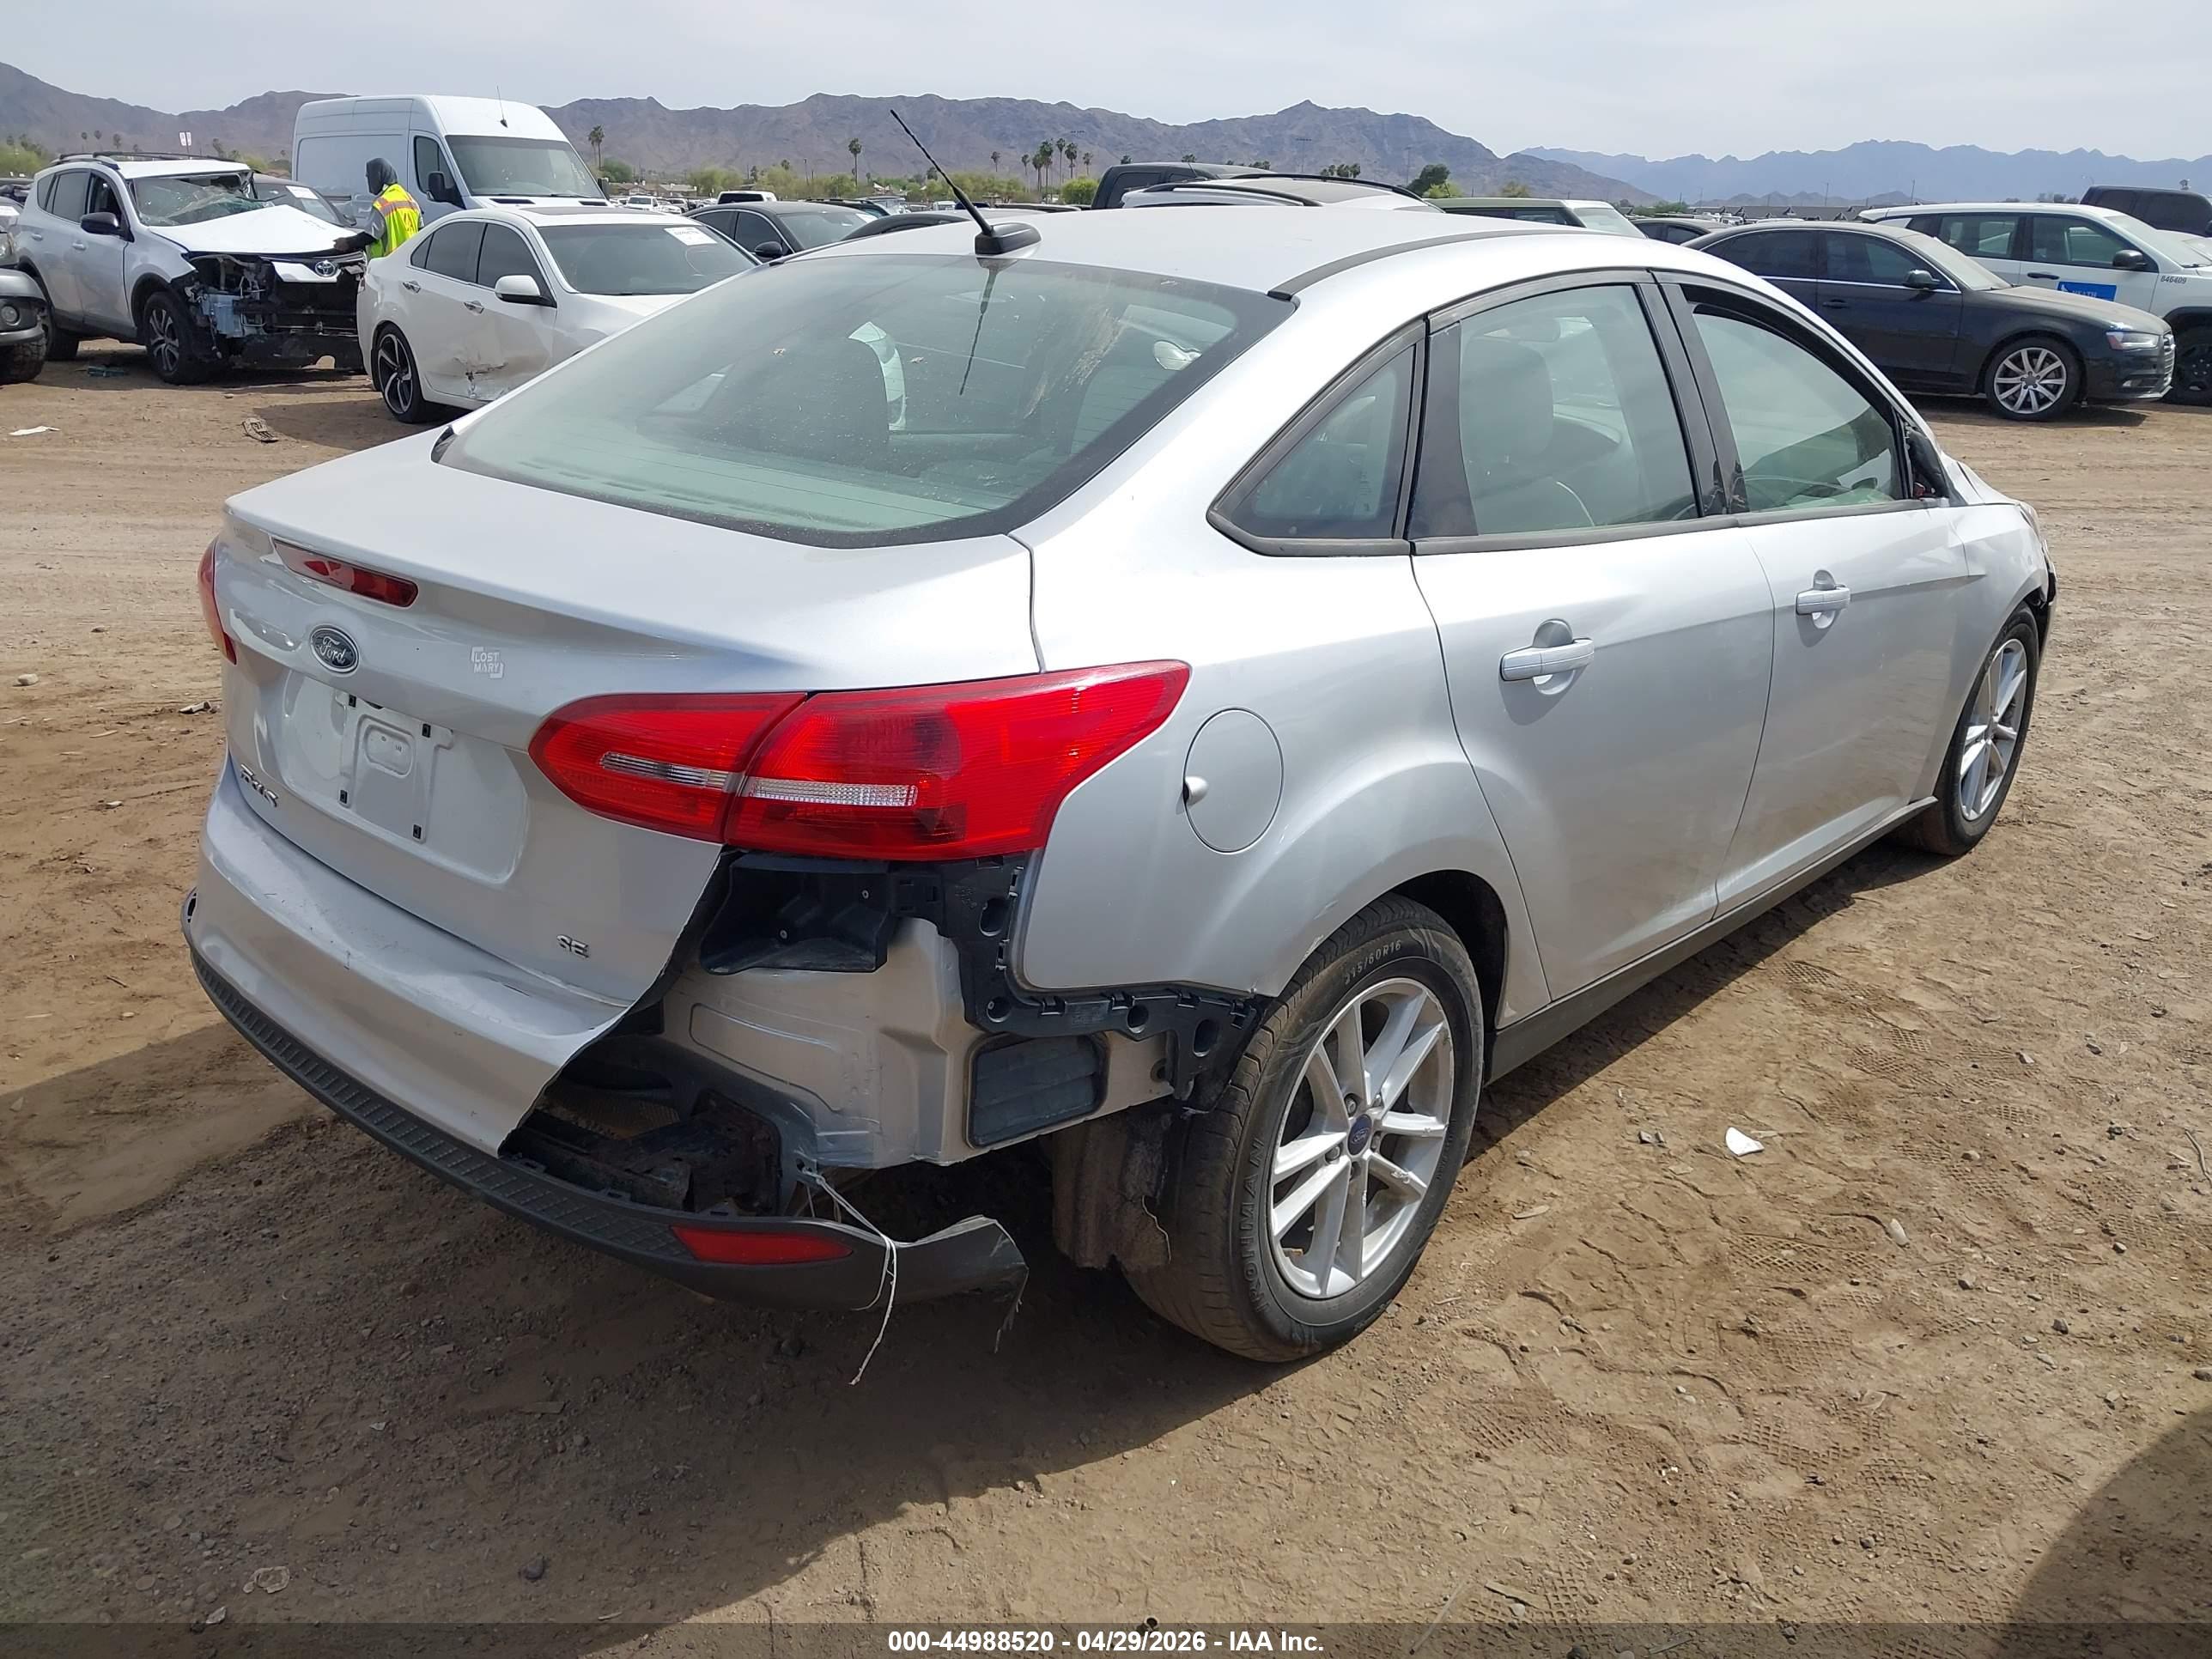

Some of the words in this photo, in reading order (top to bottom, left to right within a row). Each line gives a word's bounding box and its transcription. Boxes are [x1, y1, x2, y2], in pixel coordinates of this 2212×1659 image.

[319, 635, 346, 664] Ford
[475, 652, 500, 662] LOST
[473, 662, 500, 673] MARY
[556, 934, 589, 959] SE
[1239, 1138, 1270, 1313] IRONMAN
